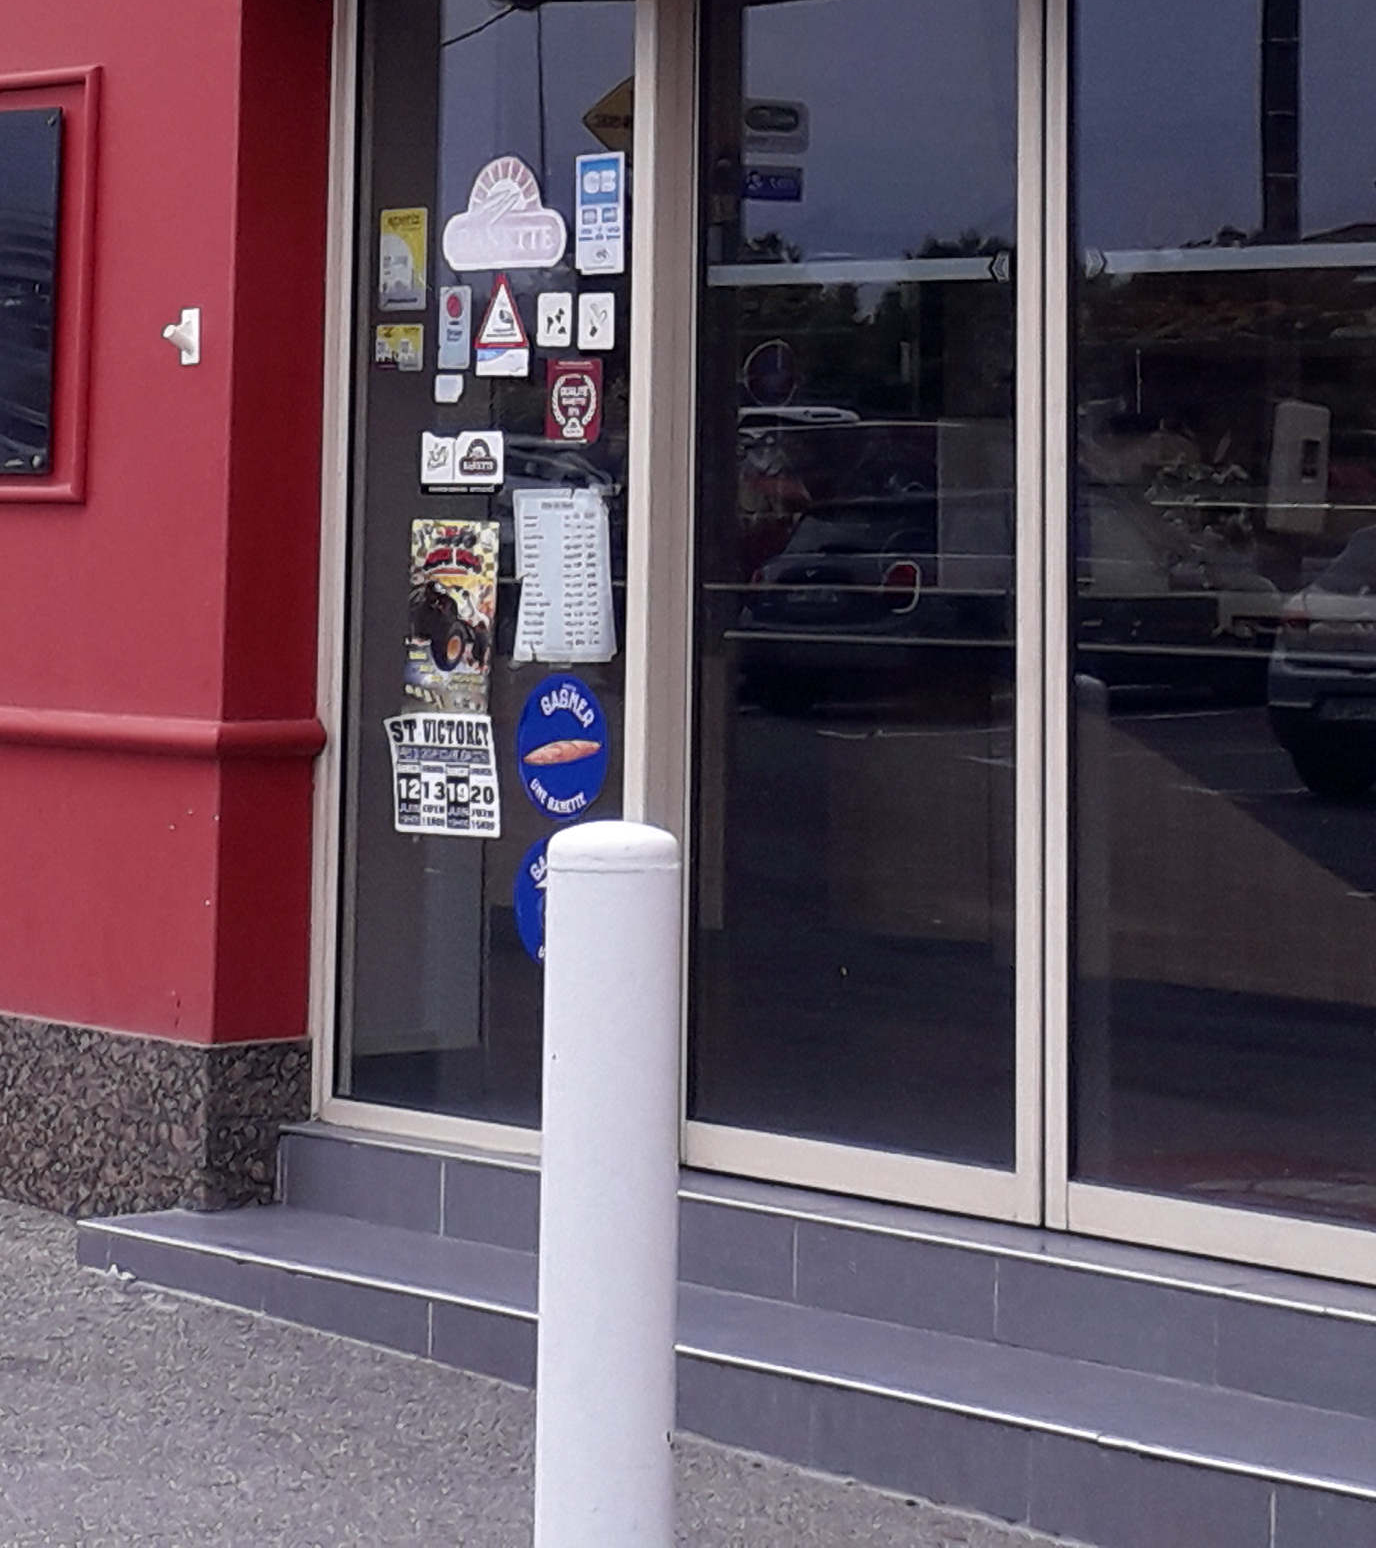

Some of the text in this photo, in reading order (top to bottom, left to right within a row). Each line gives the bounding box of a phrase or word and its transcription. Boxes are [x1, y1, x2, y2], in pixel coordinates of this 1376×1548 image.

[390, 719, 489, 747] ST VICTORET
[399, 778, 421, 800] 12
[470, 785, 495, 805] 20
